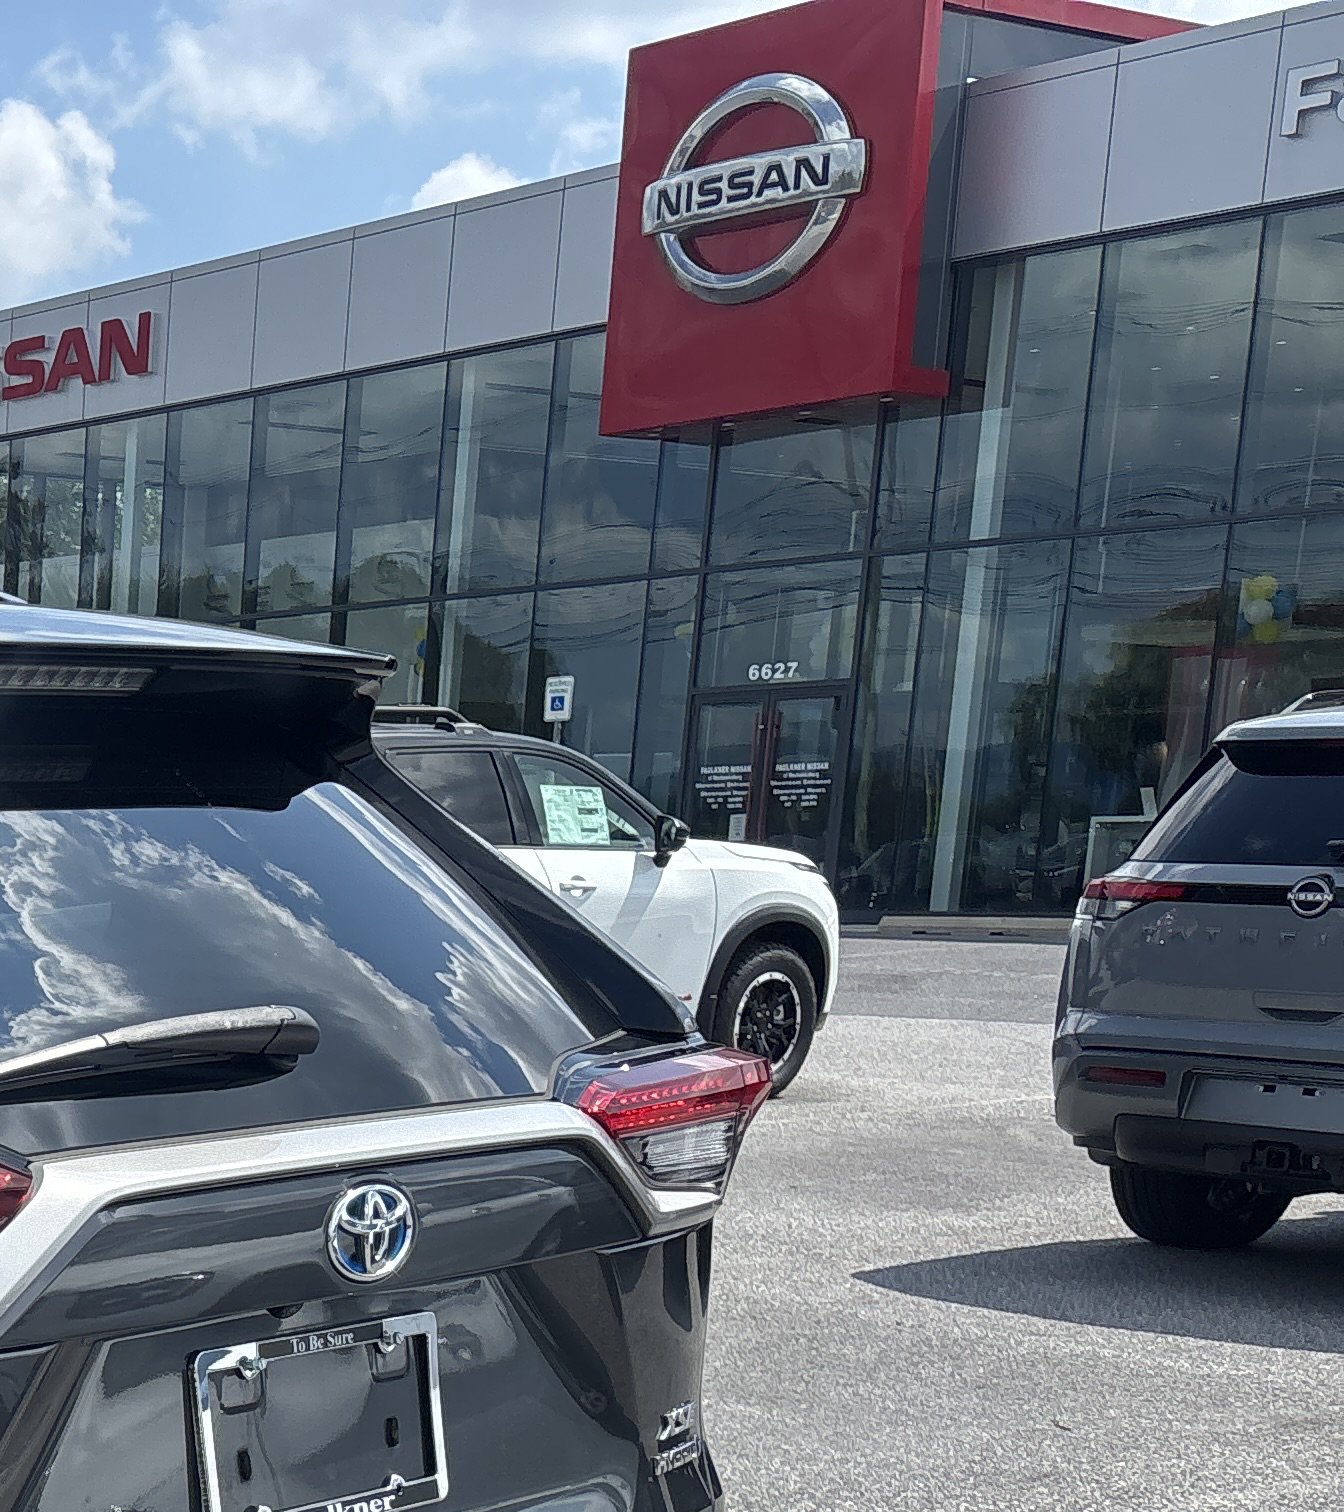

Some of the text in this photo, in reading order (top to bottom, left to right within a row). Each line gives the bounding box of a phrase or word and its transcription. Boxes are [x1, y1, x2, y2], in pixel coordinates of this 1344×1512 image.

[1280, 58, 1344, 137] F
[656, 152, 831, 221] NISSAN
[748, 661, 799, 681] 6627
[1287, 892, 1333, 902] NISSAN
[290, 1330, 355, 1354] To Be Sure
